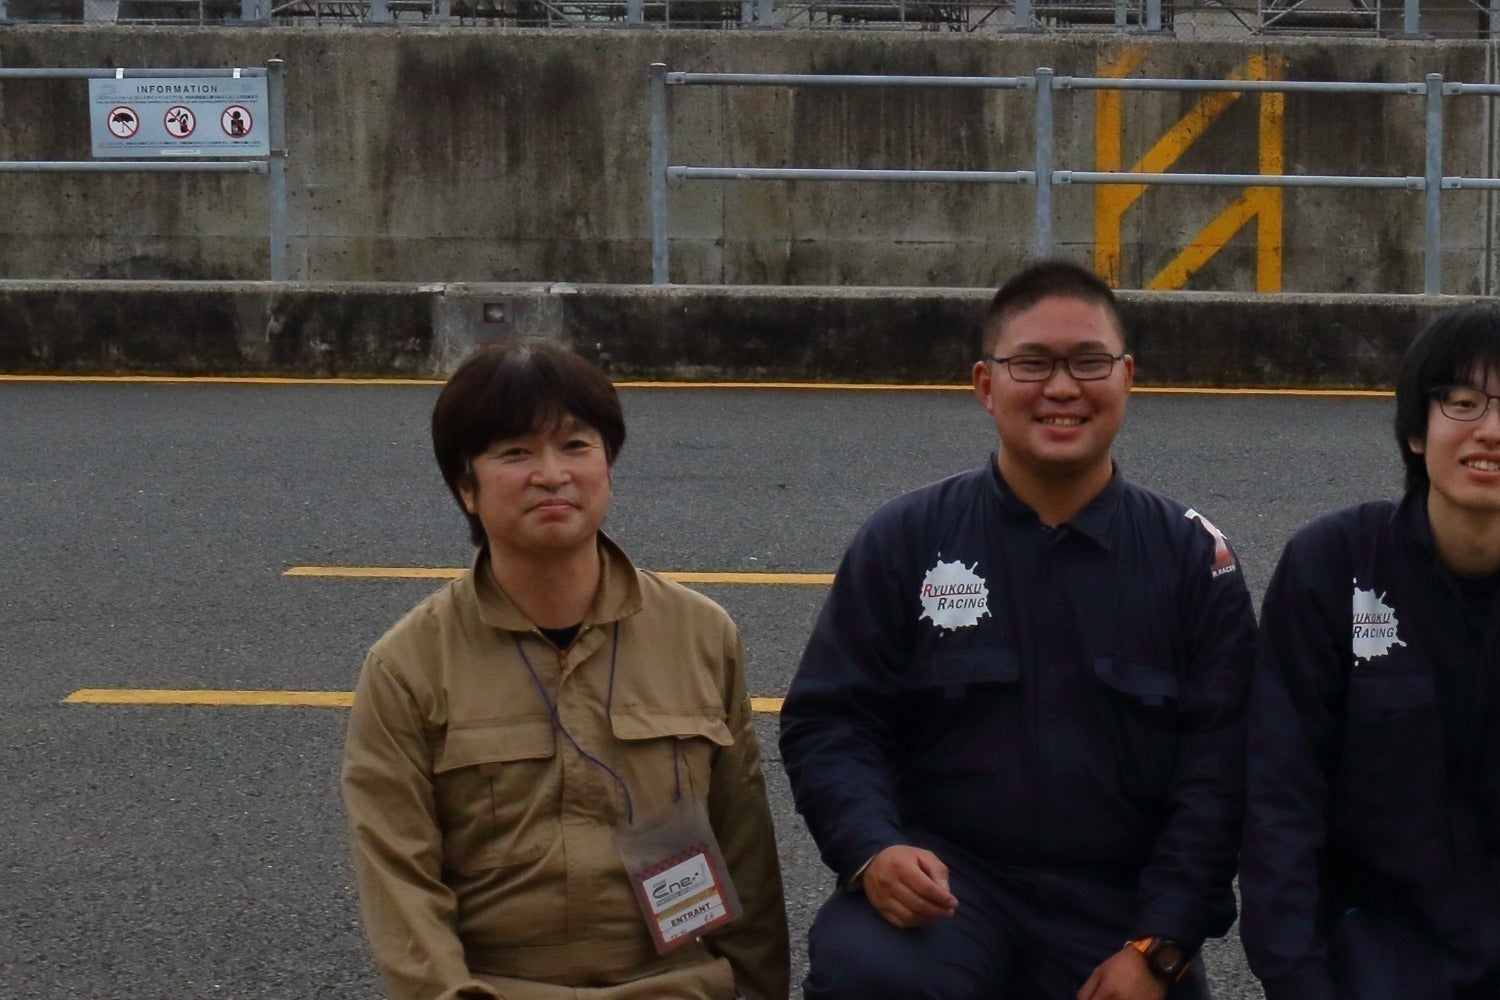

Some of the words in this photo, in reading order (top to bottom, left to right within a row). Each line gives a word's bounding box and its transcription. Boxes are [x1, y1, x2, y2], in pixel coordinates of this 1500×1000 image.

[136, 85, 218, 94] INFORMATION
[922, 583, 982, 598] RYUKOKU
[937, 597, 985, 610] RACING
[1353, 625, 1395, 638] RACING
[670, 902, 711, 927] ENTRANT
